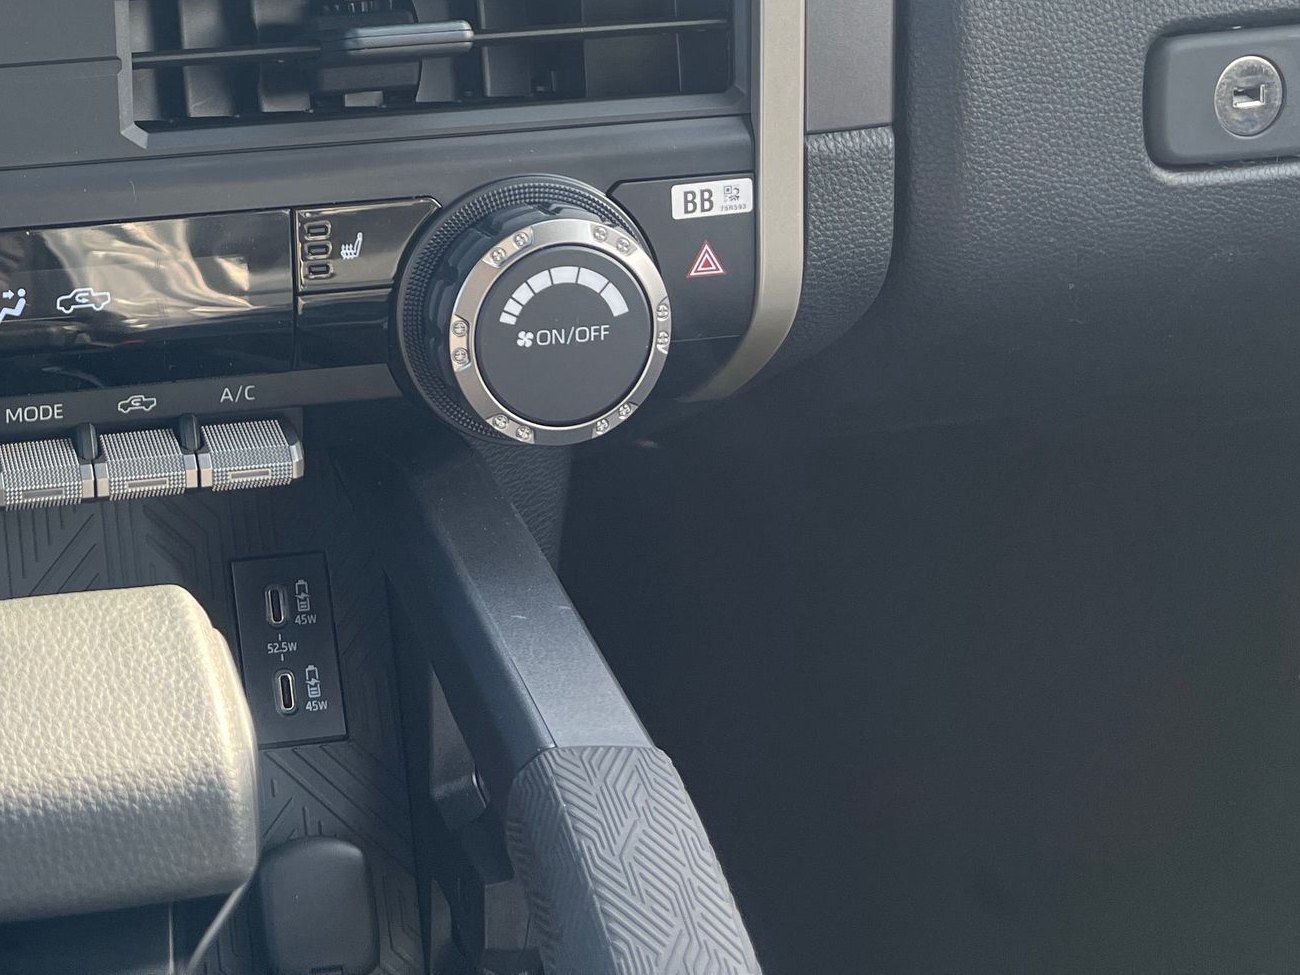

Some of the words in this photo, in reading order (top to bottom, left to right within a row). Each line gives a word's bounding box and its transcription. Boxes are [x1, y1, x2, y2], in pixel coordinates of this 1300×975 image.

[684, 189, 713, 214] BB
[536, 325, 609, 346] ON/OFF
[220, 385, 256, 403] A/C
[6, 404, 63, 423] MODE
[295, 614, 317, 625] 45W
[267, 642, 297, 654] 52.5W
[305, 700, 328, 711] 45W
